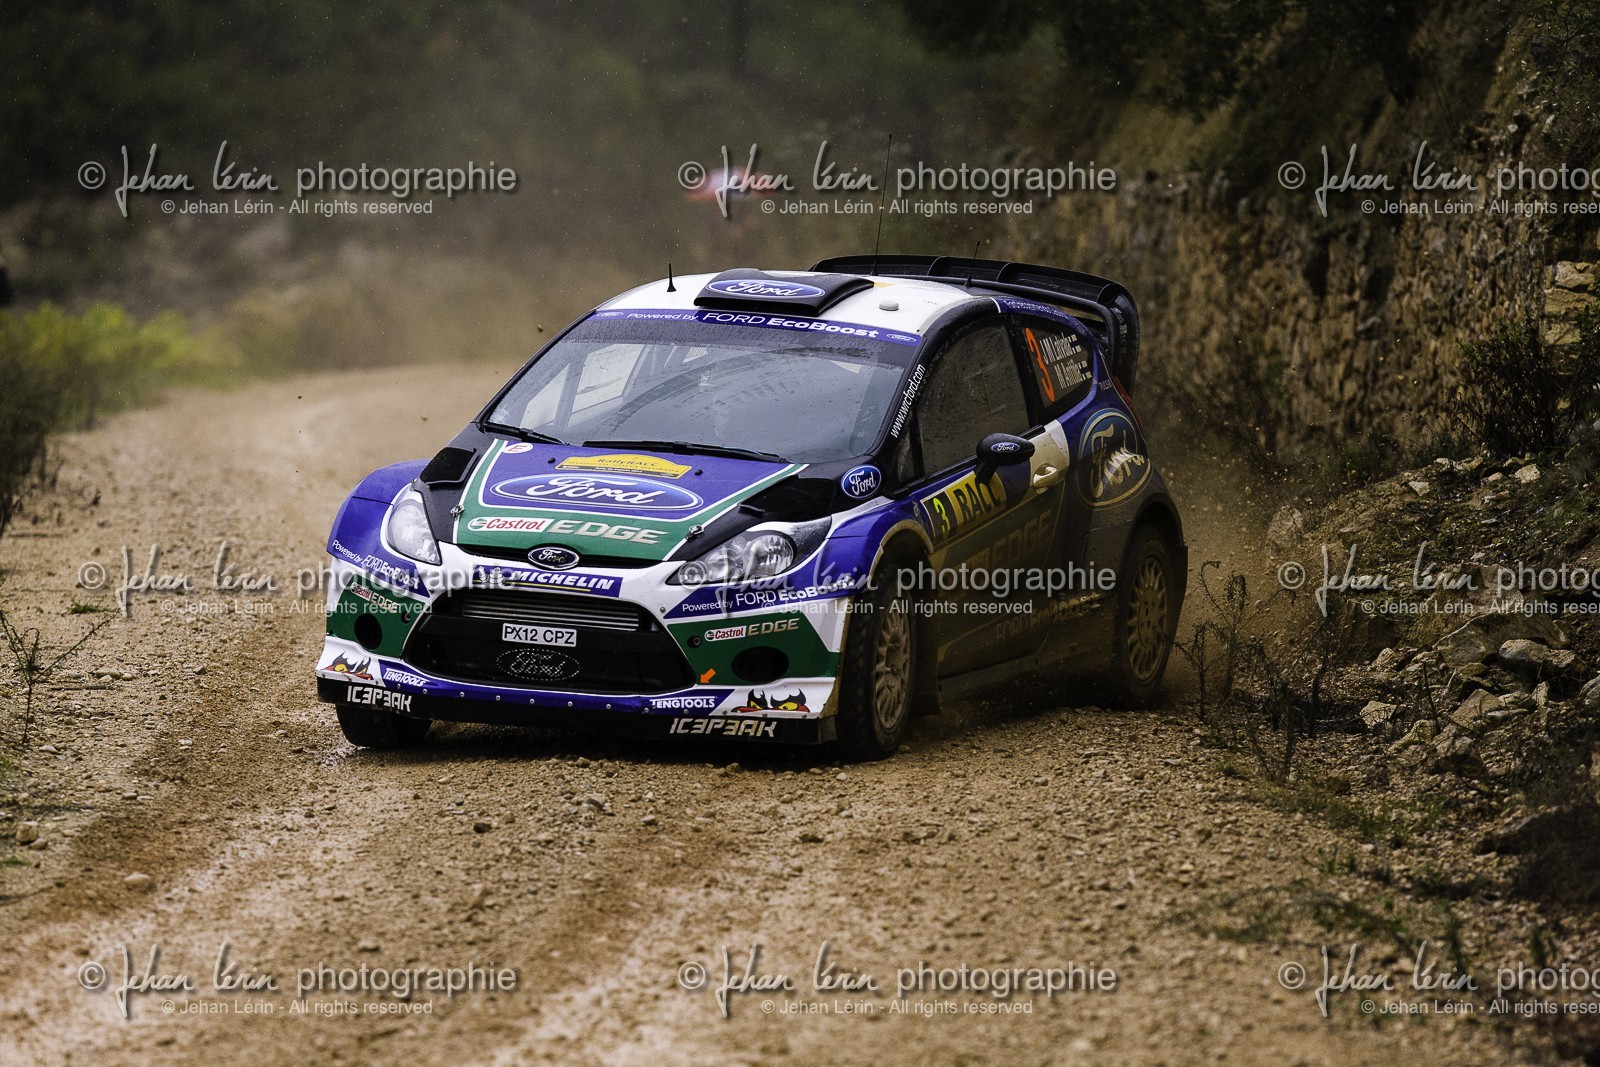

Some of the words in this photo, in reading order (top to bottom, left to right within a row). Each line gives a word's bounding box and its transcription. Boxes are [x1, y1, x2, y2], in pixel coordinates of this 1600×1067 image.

[725, 280, 805, 296] Ford
[627, 312, 681, 320] Powered
[703, 313, 765, 324] FORD
[767, 318, 879, 338] EcoBoost
[1025, 328, 1055, 401] 3
[890, 363, 926, 438] www.wrcford.com
[525, 476, 667, 504] Ford
[849, 469, 877, 495] Ford
[933, 498, 951, 537] 3
[486, 518, 546, 530] Castrol
[547, 519, 669, 544] EDGE
[332, 540, 356, 561] Powered
[354, 555, 362, 564] by
[361, 555, 382, 571] FORD
[382, 562, 420, 590] EcoBoost
[539, 549, 567, 563] Ford
[509, 569, 614, 590] MICHELIN
[371, 593, 400, 613] EDGE
[682, 602, 720, 612] Powered
[722, 600, 733, 609] by
[736, 591, 776, 606] FORD
[778, 576, 855, 601] EcoBoost
[504, 626, 538, 641] PX12
[543, 629, 575, 645] CPZ
[715, 628, 744, 640] Castrol
[748, 618, 800, 636] EDGE
[383, 668, 430, 687] TENGTOOLS
[649, 695, 716, 709] TENGTOOLS
